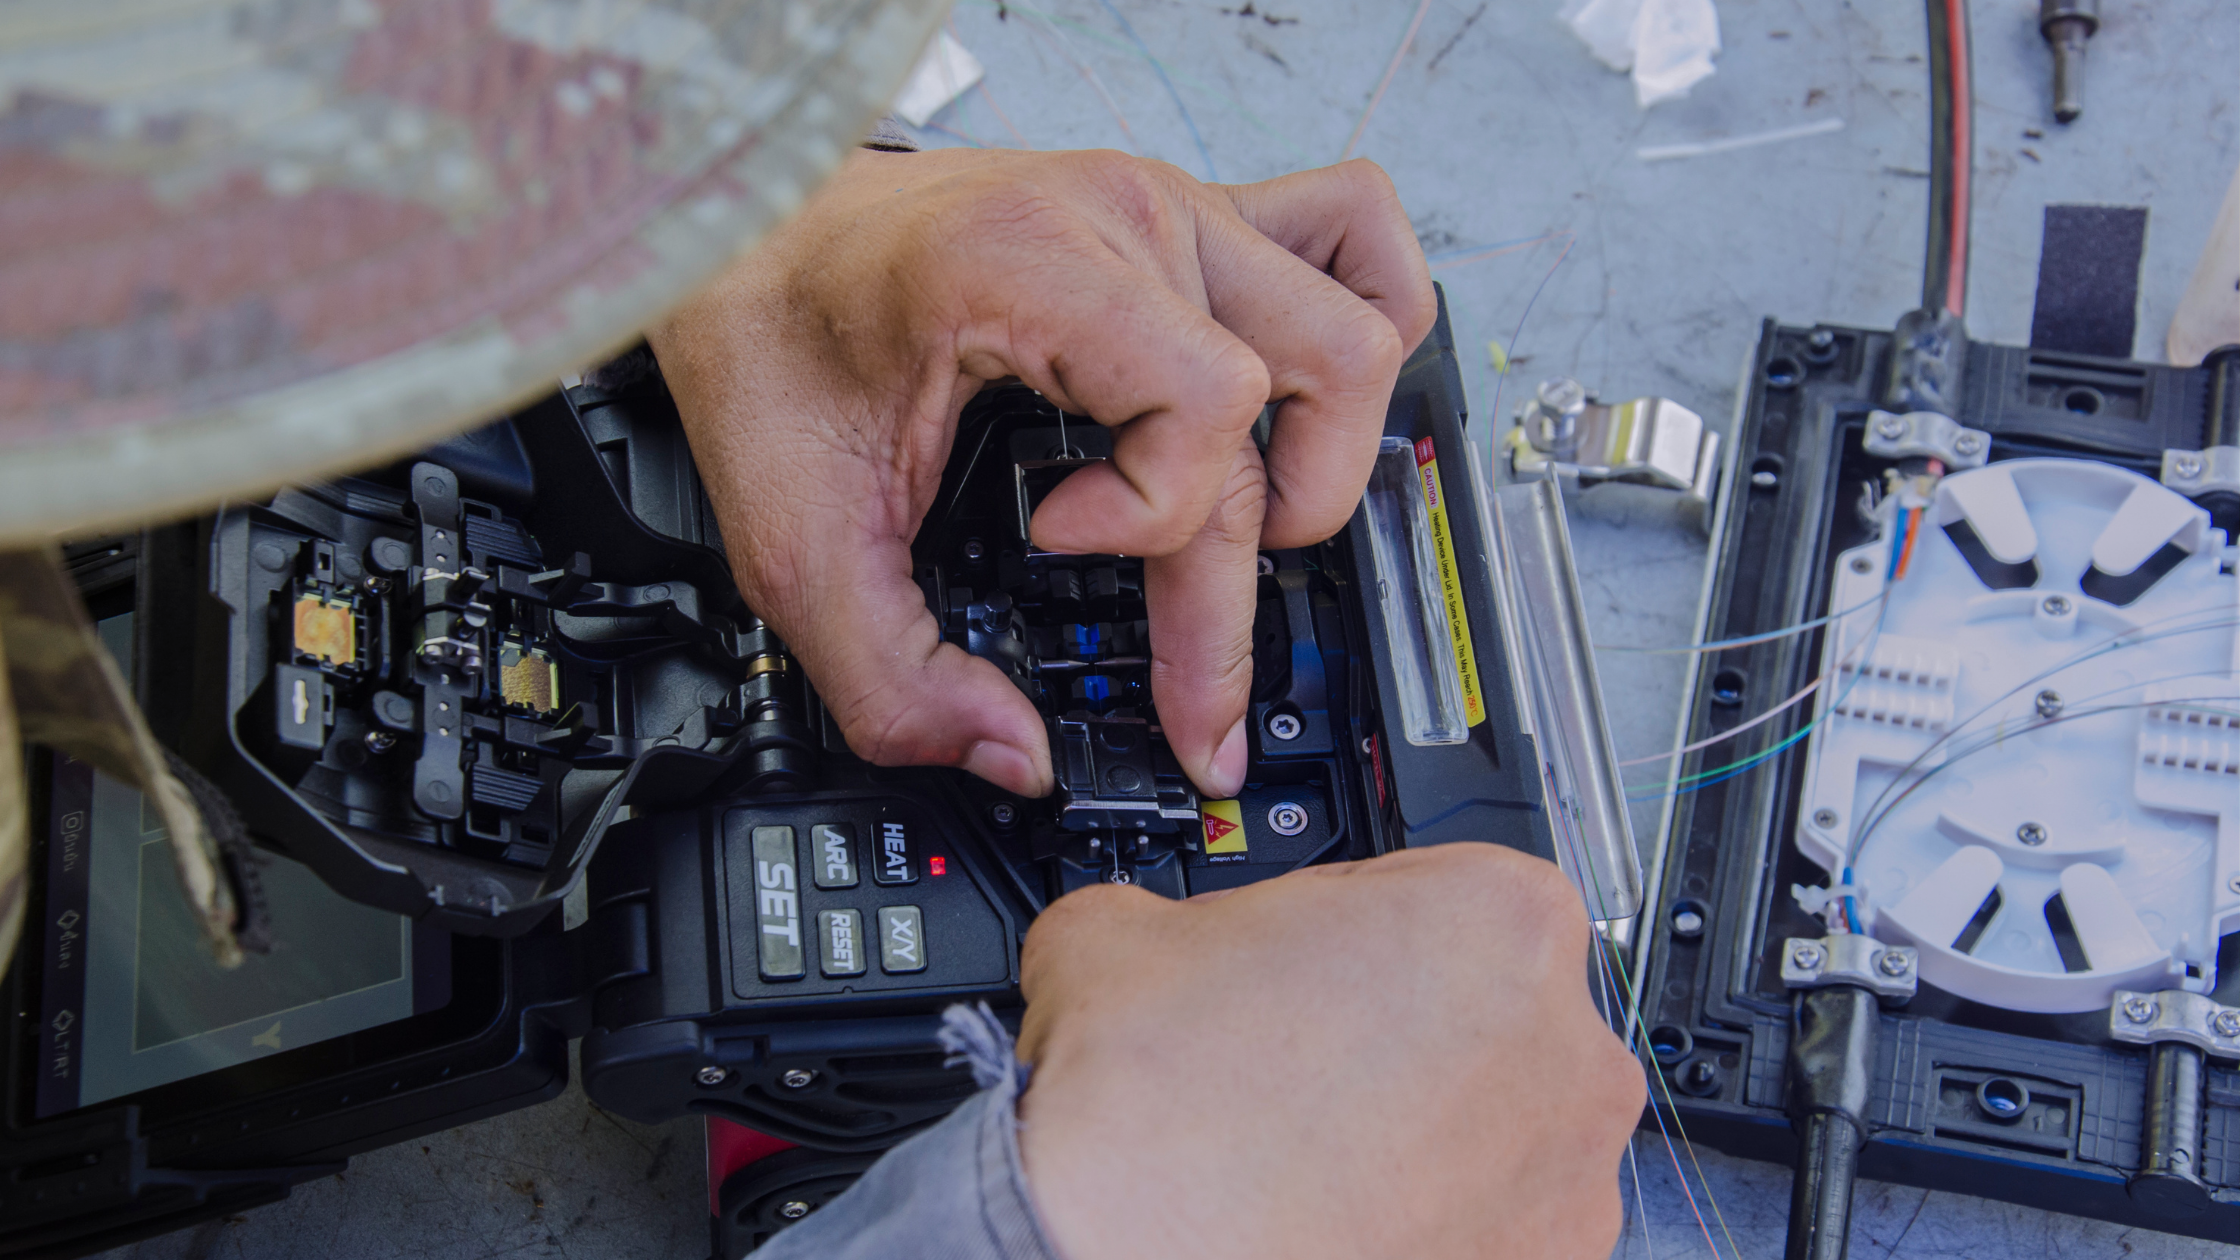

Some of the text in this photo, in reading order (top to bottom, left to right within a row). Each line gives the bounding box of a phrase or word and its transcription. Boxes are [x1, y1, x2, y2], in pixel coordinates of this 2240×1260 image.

[1424, 467, 1437, 508] CAUTION:
[1433, 511, 1442, 538] Heating
[1437, 537, 1445, 559] Device
[1441, 560, 1450, 580] Under
[1448, 592, 1455, 600] In
[1449, 600, 1457, 620] Some
[1460, 658, 1468, 674] May
[1464, 674, 1473, 696] Reach
[823, 829, 849, 881] ARC
[883, 823, 908, 880] HEAT
[758, 860, 799, 947] SET
[831, 912, 854, 970] RESET
[890, 916, 916, 962] X/Y
[252, 1020, 281, 1049] Y
[53, 1031, 71, 1078] LT/RT
